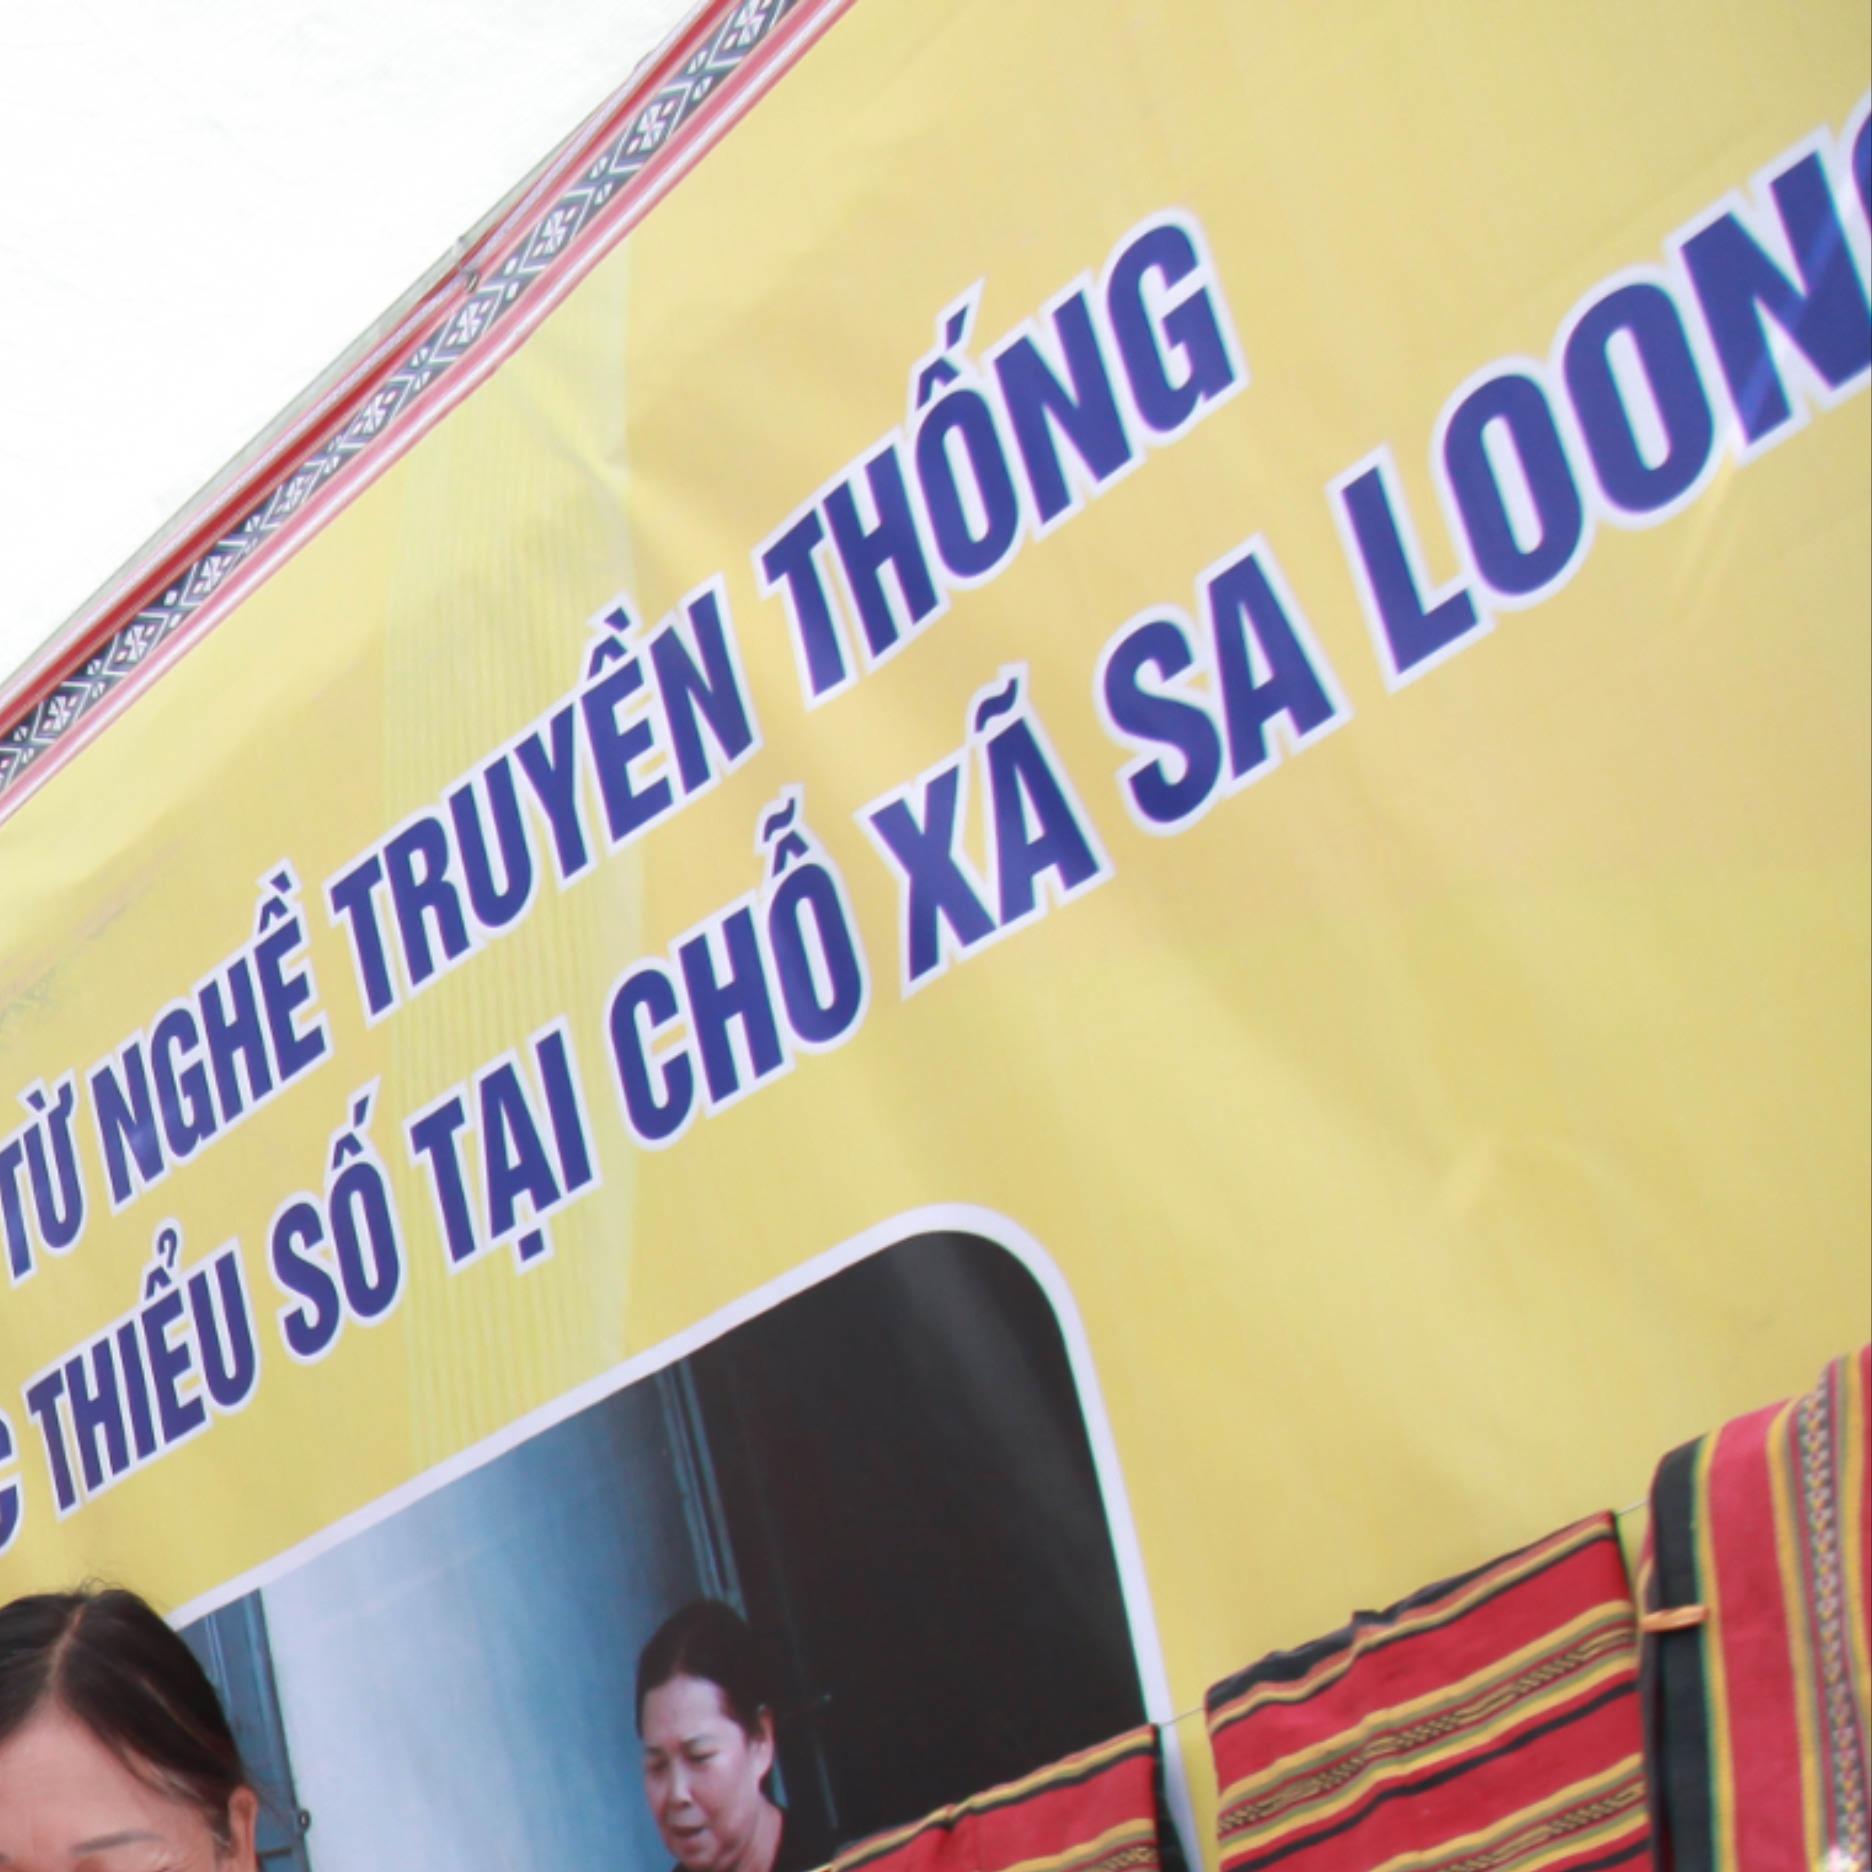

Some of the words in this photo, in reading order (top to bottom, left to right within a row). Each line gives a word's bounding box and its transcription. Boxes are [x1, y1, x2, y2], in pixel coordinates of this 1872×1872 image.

[26, 1229, 257, 1511] THIỂU
[271, 1094, 401, 1357] SỐ
[412, 1030, 594, 1263] TẠI
[608, 796, 860, 1141] CHỖ
[867, 676, 1103, 983] XÃ
[1104, 552, 1337, 824] SA
[1341, 110, 1871, 677] LOON
[91, 870, 328, 1204] NGHỀ
[330, 606, 754, 1016] TRUYỀN
[761, 222, 1237, 698] THỐNG
